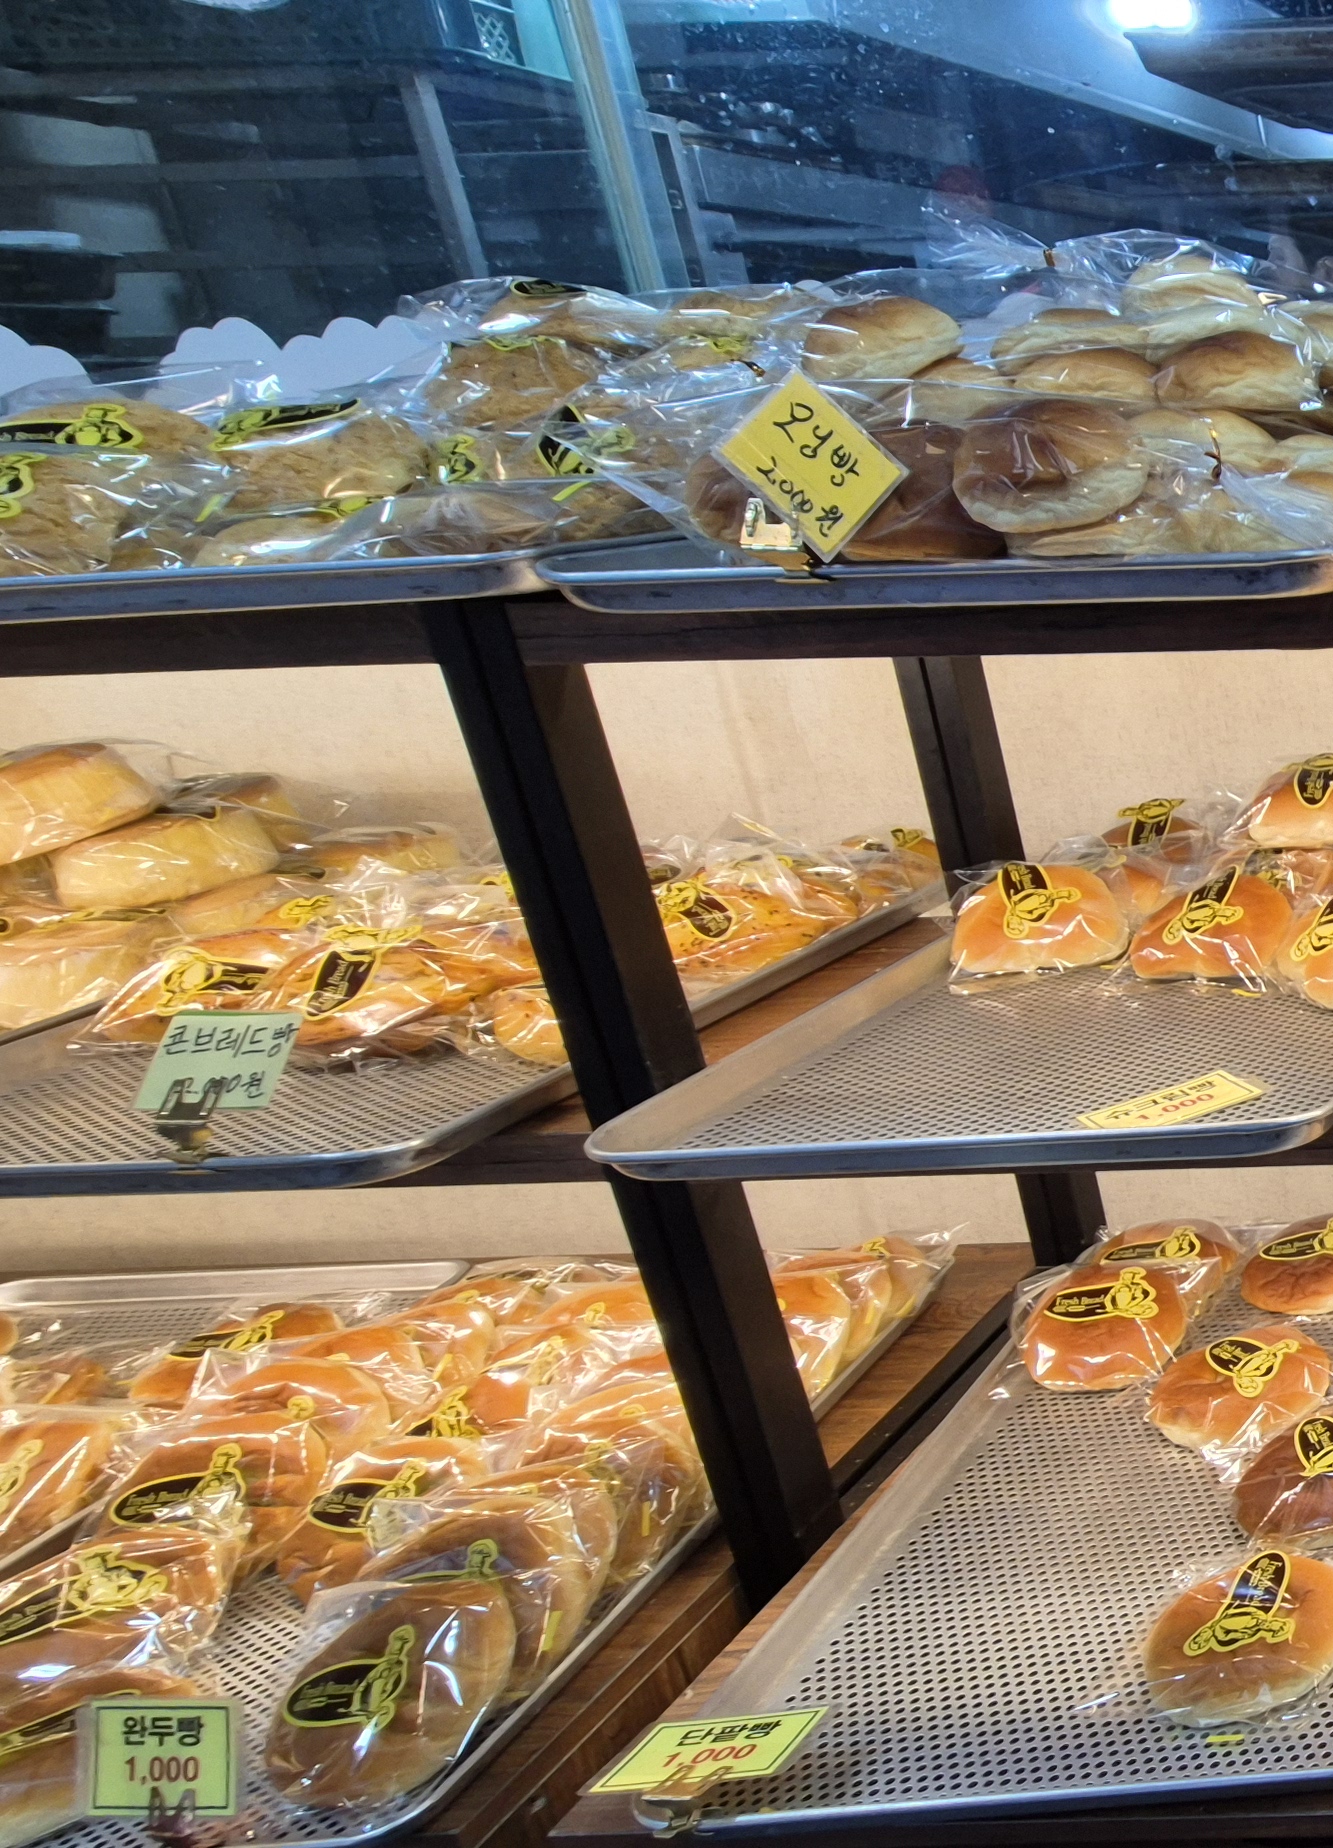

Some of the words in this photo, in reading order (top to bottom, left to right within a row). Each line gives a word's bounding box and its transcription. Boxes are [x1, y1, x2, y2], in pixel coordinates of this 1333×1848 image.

[162, 1022, 300, 1058] 콘브레드빵
[121, 1714, 205, 1748] 완두빵
[676, 1719, 783, 1748] 단팥빵
[124, 1755, 200, 1786] 1,000
[662, 1743, 758, 1770] 1,000
